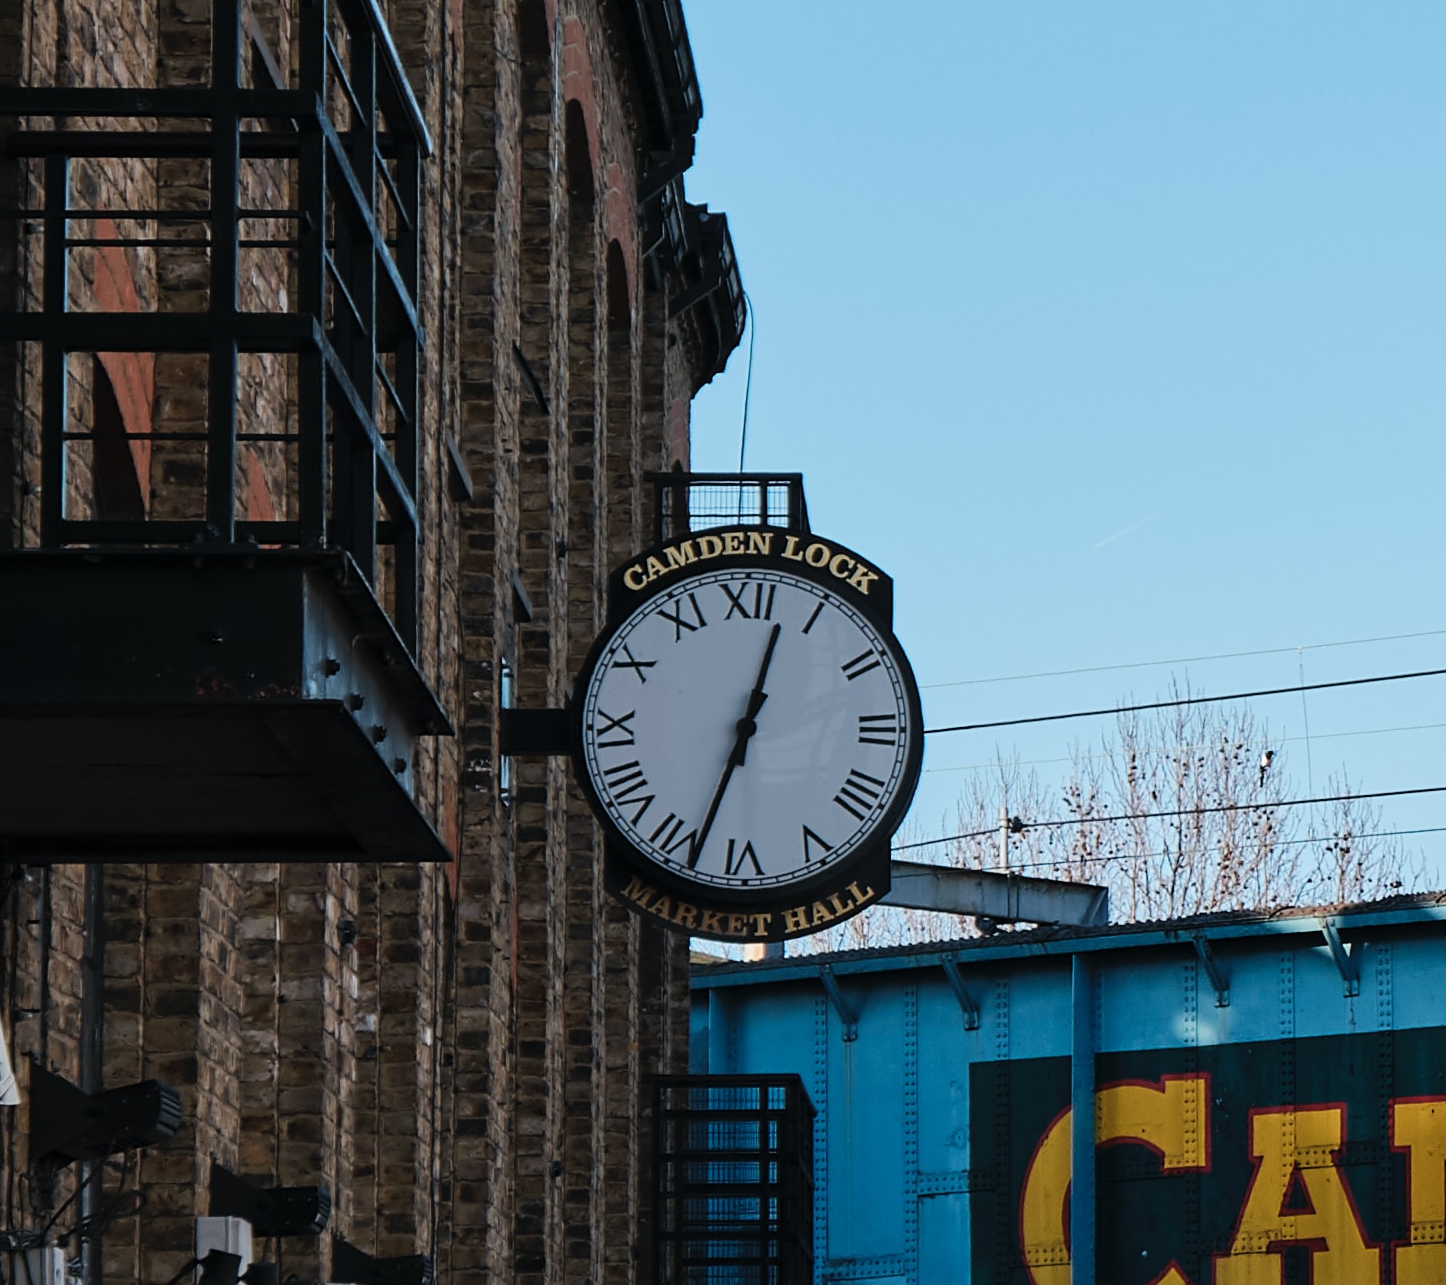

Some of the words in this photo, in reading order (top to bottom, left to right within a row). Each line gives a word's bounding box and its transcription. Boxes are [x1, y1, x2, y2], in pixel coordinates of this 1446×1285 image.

[623, 532, 774, 591] CAMDEN
[781, 536, 880, 595] LOCK
[657, 593, 708, 642] XI
[720, 583, 776, 620] XII
[802, 602, 824, 634] I
[612, 644, 657, 684] X
[841, 648, 880, 681] II
[598, 709, 635, 749] IX
[858, 714, 896, 747] III
[803, 825, 834, 863] V
[620, 874, 772, 937] MARKET
[781, 880, 875, 934] HALL
